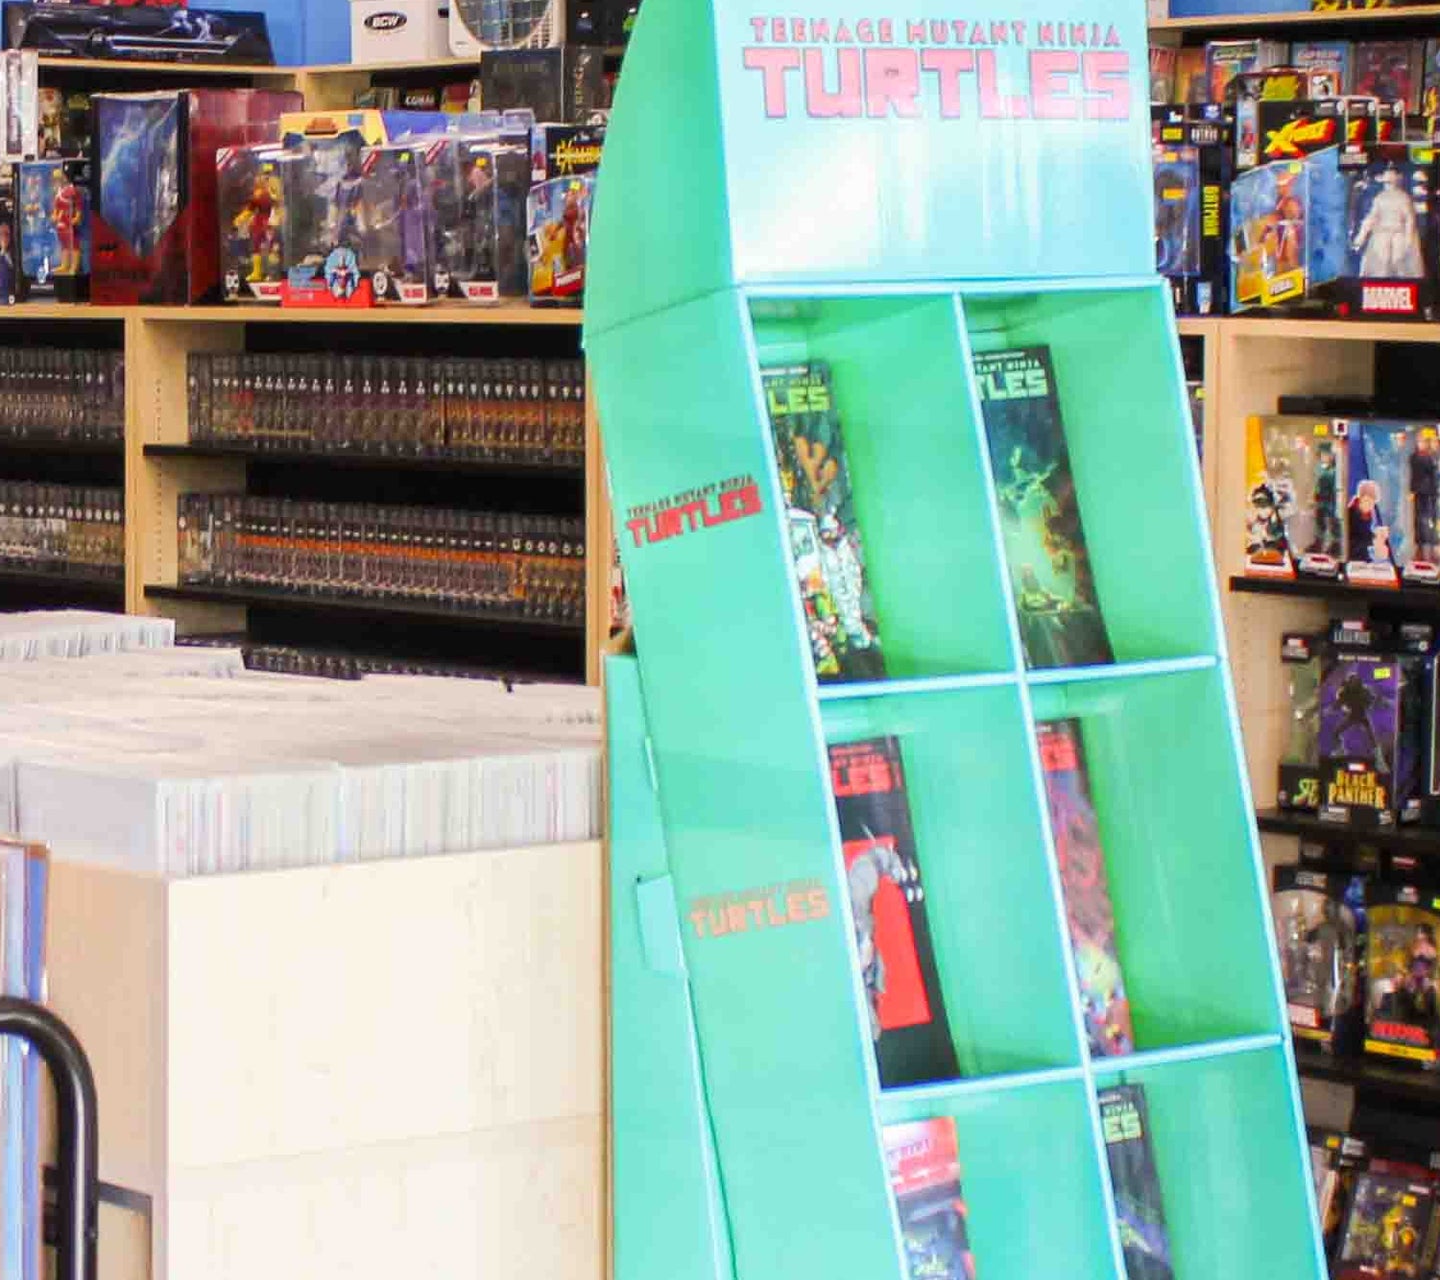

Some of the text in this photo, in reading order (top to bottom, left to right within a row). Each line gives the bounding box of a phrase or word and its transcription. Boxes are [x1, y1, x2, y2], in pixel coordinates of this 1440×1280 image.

[371, 14, 401, 28] BCW
[748, 17, 1122, 48] TEENAGE MUTANT NINJA
[742, 46, 1131, 120] TURTLES
[1362, 285, 1414, 311] MARVEL
[766, 386, 831, 415] LES
[975, 369, 1049, 401] TLES
[625, 484, 764, 548] TURTLES
[833, 760, 894, 797] LES
[1335, 769, 1377, 788] BLACK
[1327, 782, 1389, 810] PANTHER
[686, 886, 831, 940] TURTLES
[1103, 1112, 1142, 1144] ES
